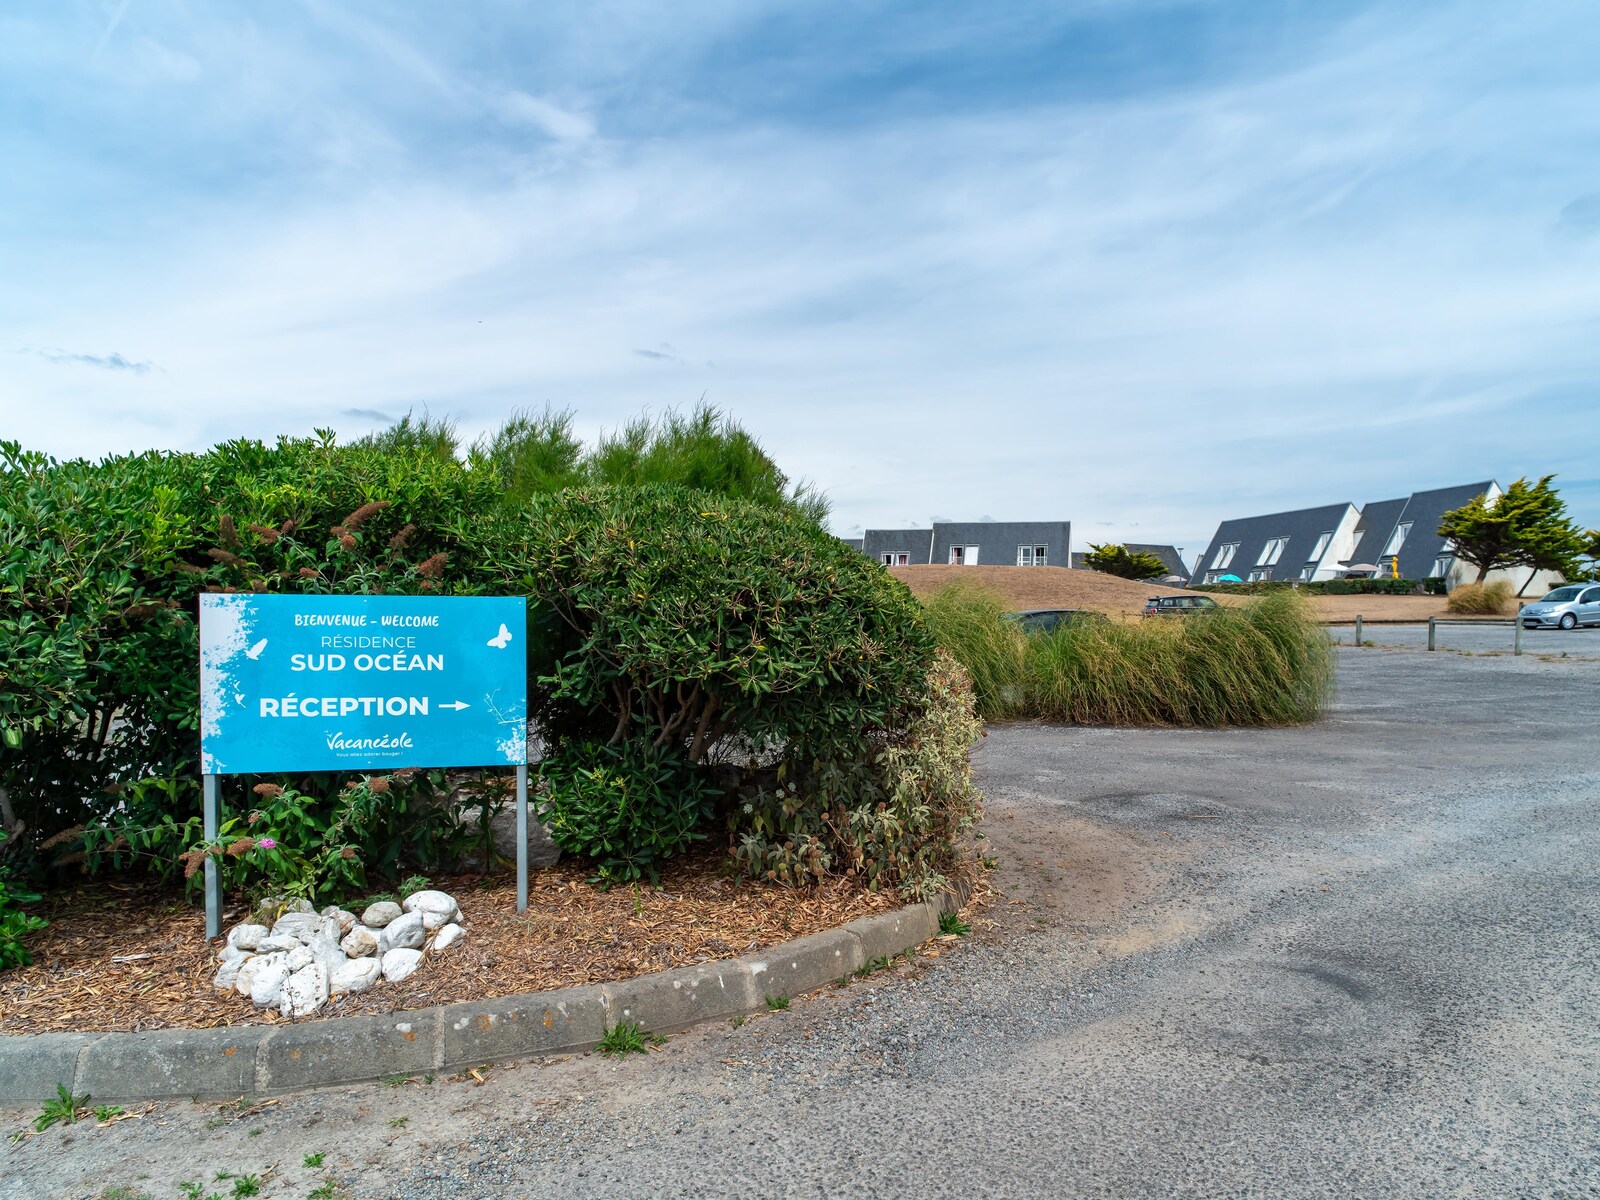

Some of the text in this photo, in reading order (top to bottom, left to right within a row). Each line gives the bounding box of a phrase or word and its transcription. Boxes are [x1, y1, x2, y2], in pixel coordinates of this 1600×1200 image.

[294, 614, 367, 627] BIENVENUE
[381, 614, 440, 627] WELCOME
[321, 634, 416, 648] RÉSIDENCE
[291, 649, 444, 672] SUD OCÉAN
[259, 692, 429, 718] RÉCEPTION
[326, 731, 414, 751] Vacancéole
